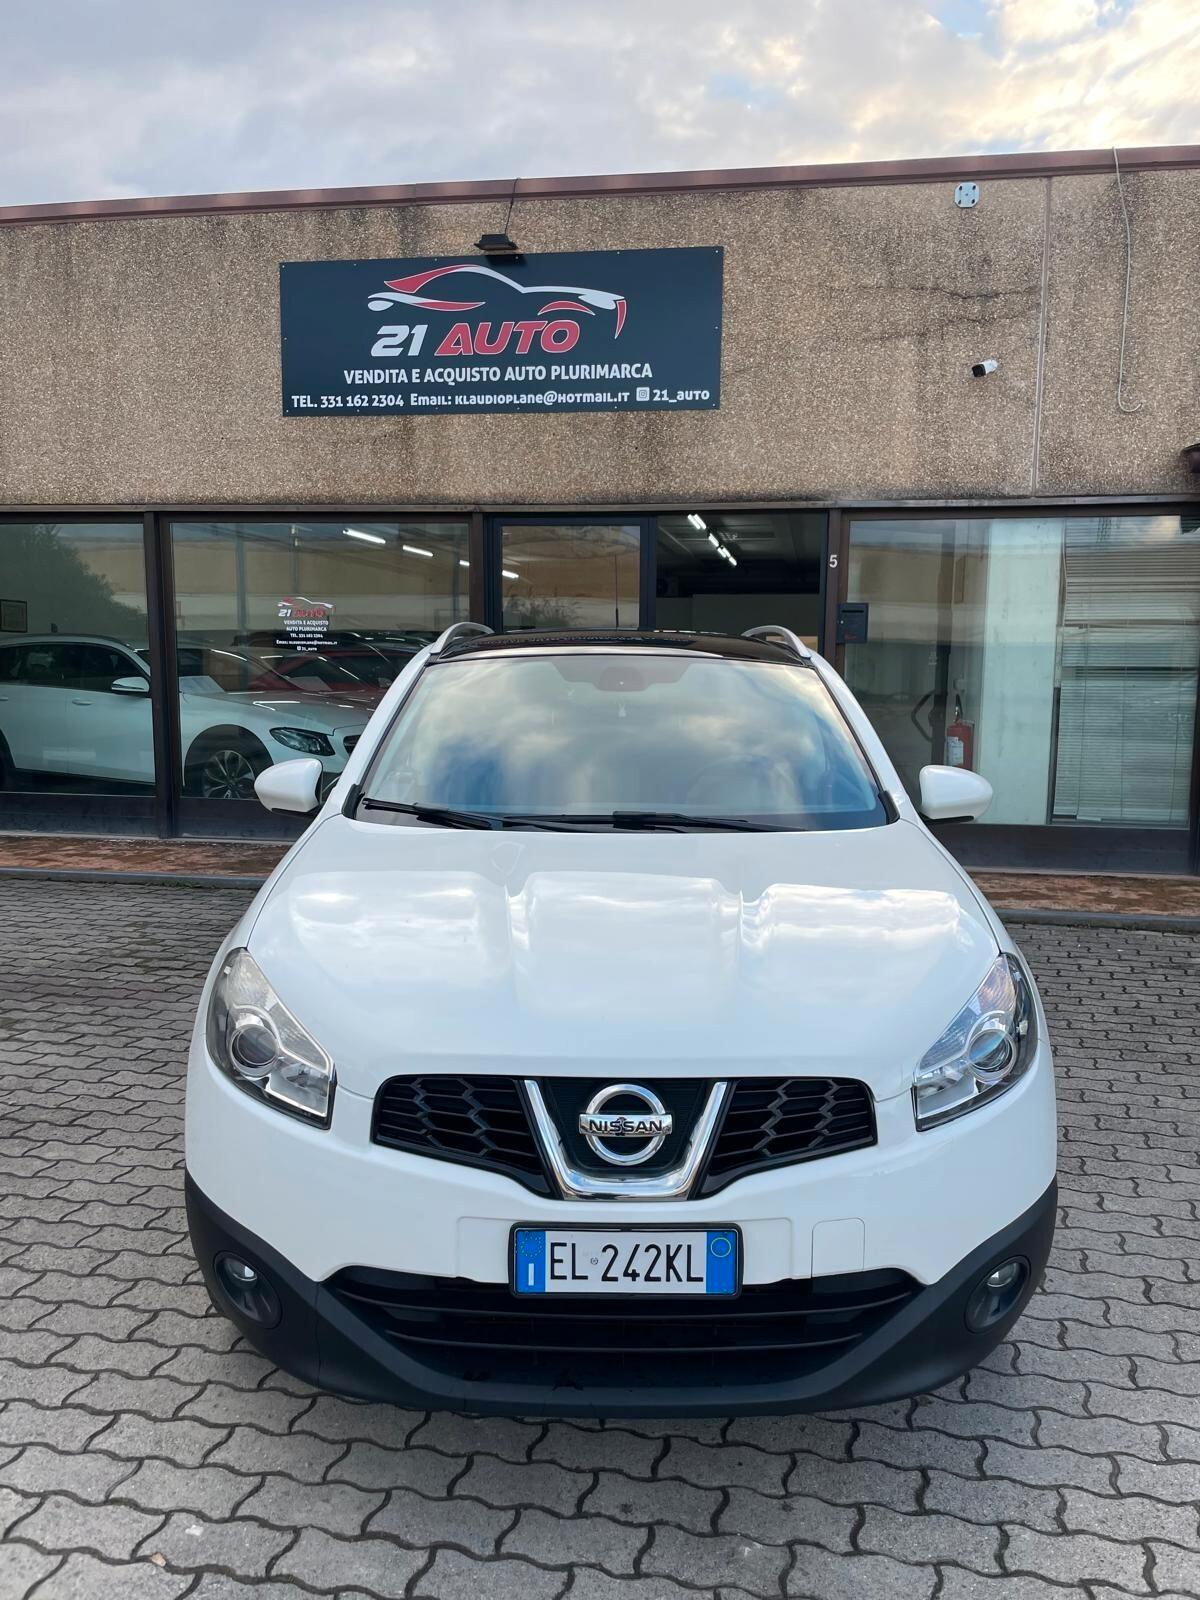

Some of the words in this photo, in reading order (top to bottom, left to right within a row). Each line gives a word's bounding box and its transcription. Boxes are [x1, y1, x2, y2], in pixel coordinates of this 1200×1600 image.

[371, 324, 429, 357] 21
[434, 319, 580, 356] AUTO
[344, 368, 409, 385] VENDITA
[411, 369, 420, 383] E
[424, 366, 501, 386] ACQUISTO
[504, 365, 547, 381] AUTO
[551, 363, 653, 380] PLURIMARCA
[291, 395, 318, 408] TEL.
[320, 395, 344, 408] 331
[346, 394, 369, 407] 162
[371, 394, 404, 407] 2304
[828, 554, 838, 568] 5
[278, 609, 292, 617] 21
[589, 1119, 663, 1132] NISSAN
[550, 1242, 589, 1280] EL
[601, 1243, 704, 1283] 242KL
